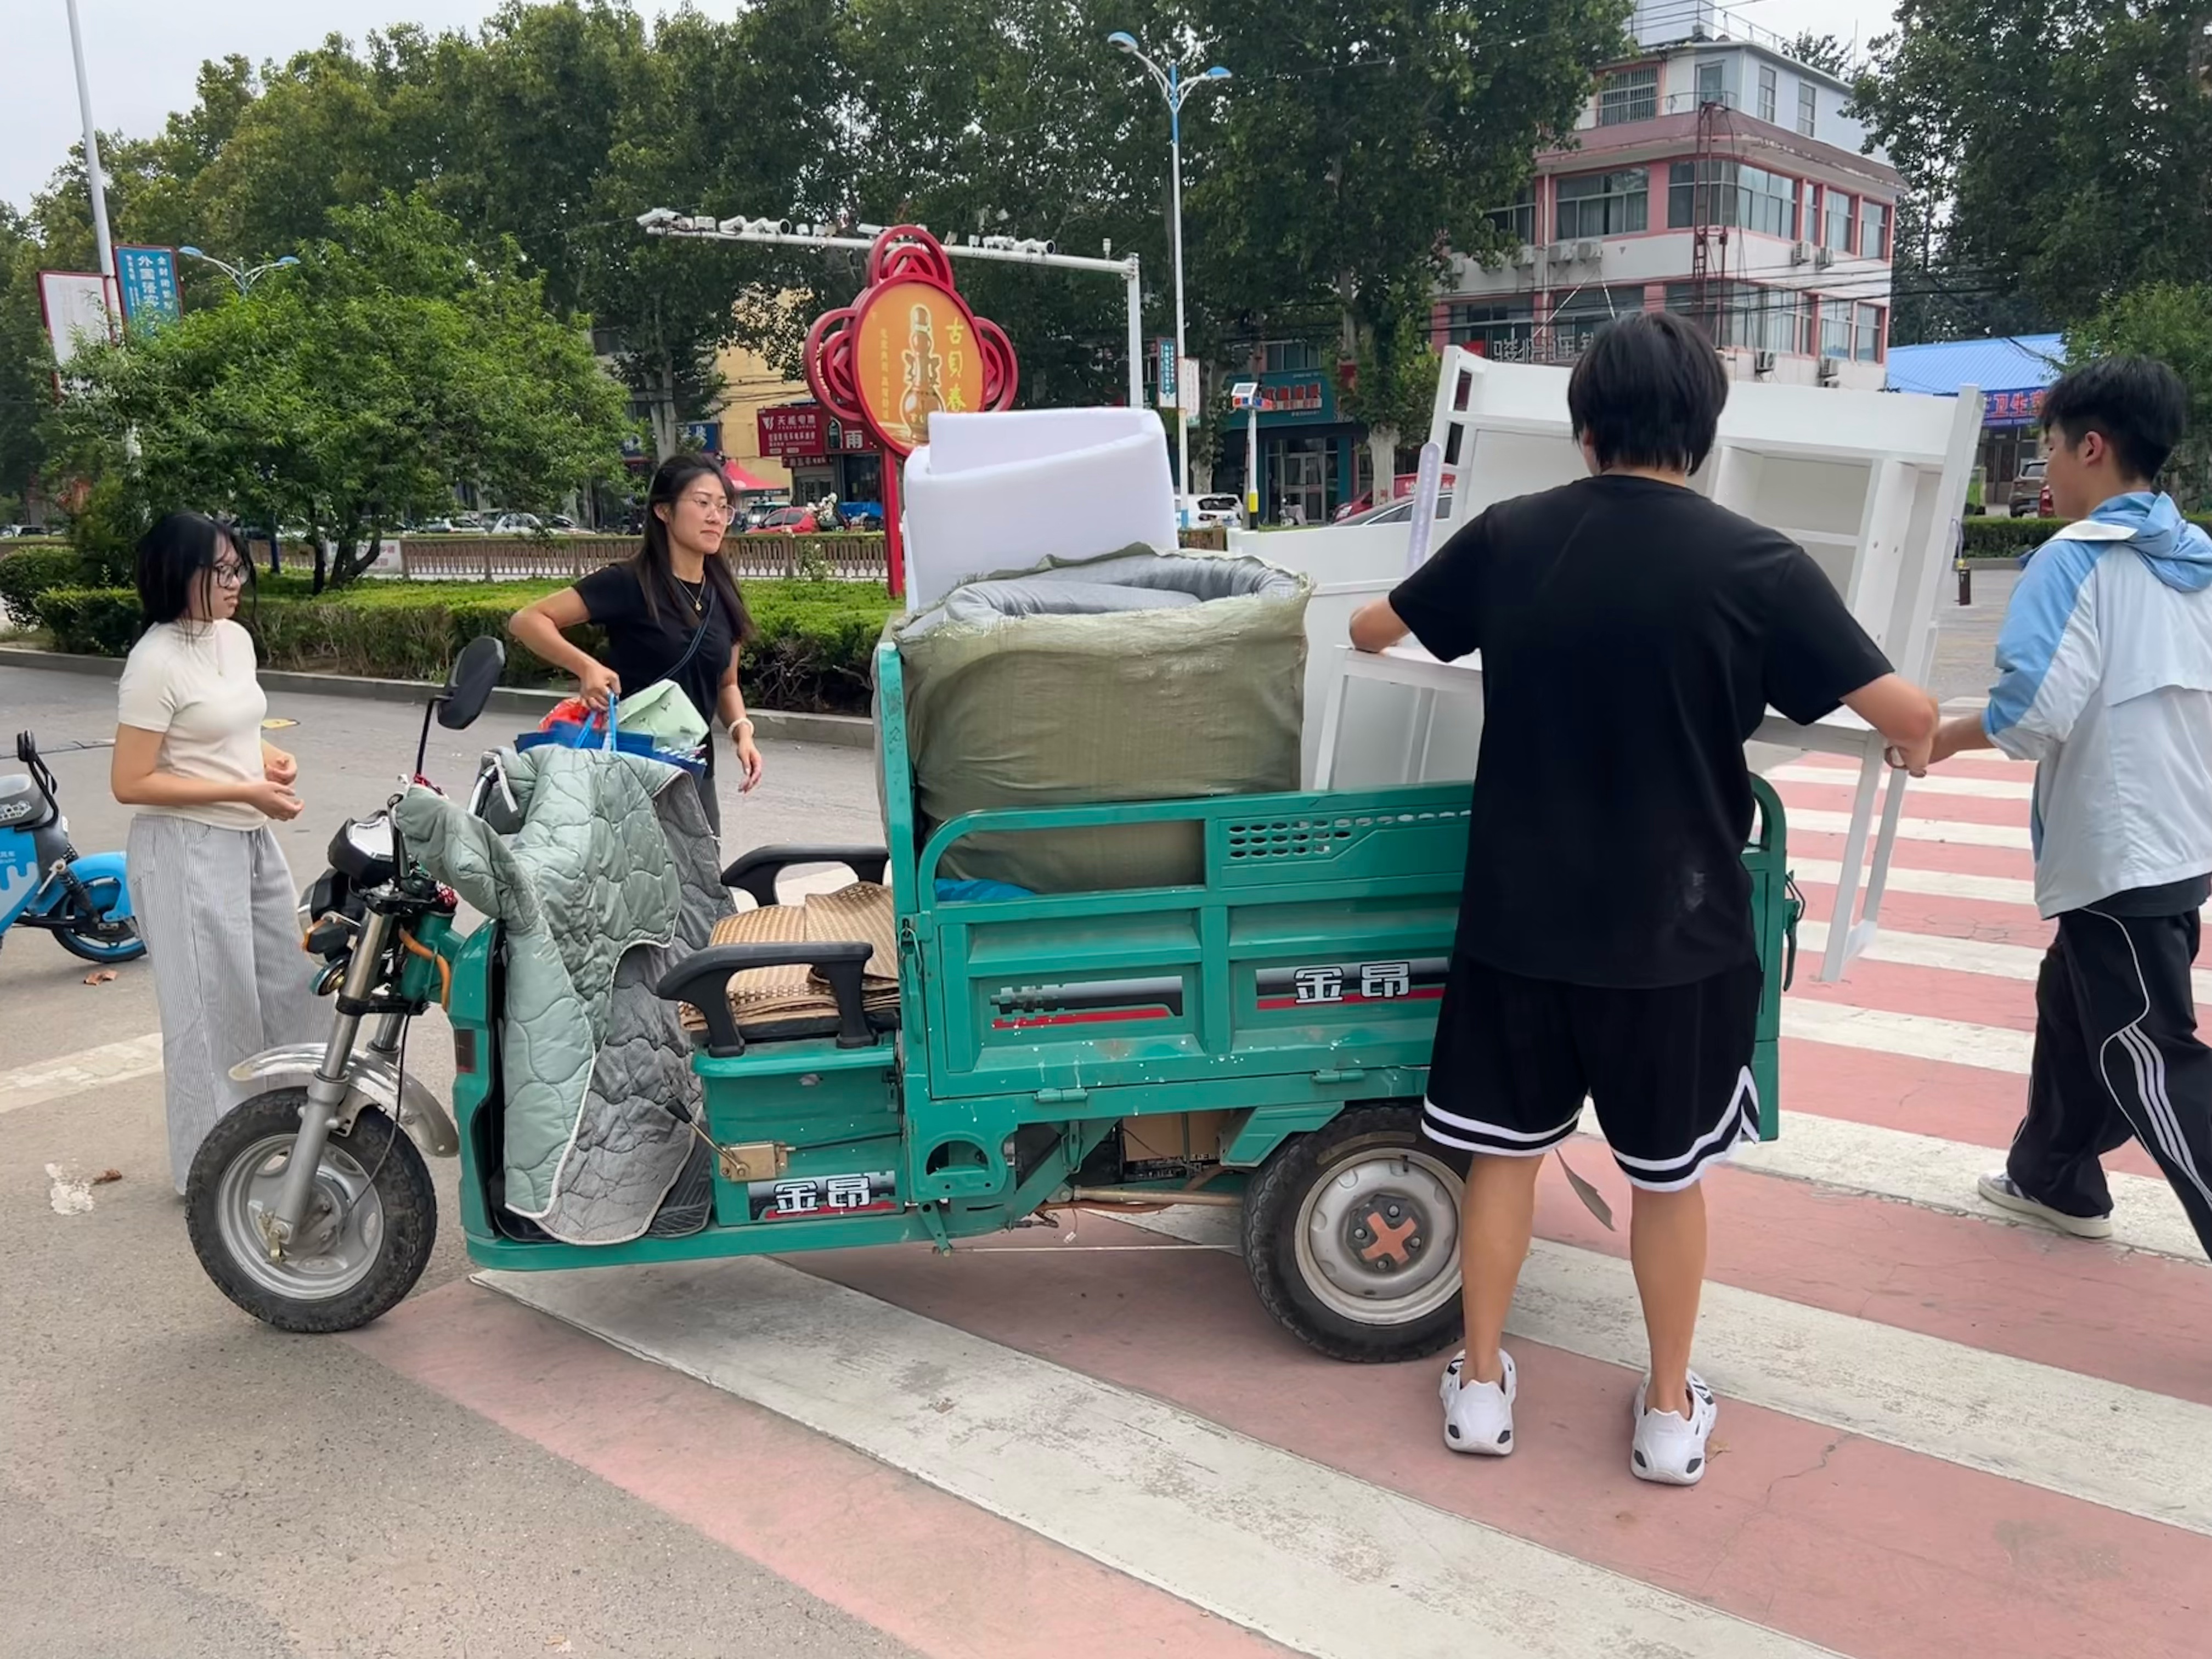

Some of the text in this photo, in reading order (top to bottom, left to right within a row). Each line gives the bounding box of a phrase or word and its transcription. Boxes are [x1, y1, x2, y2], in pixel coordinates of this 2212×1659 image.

[946, 317, 967, 411] 古贝春
[1294, 962, 1410, 1005] 金昂
[774, 1176, 871, 1214] 金昂
